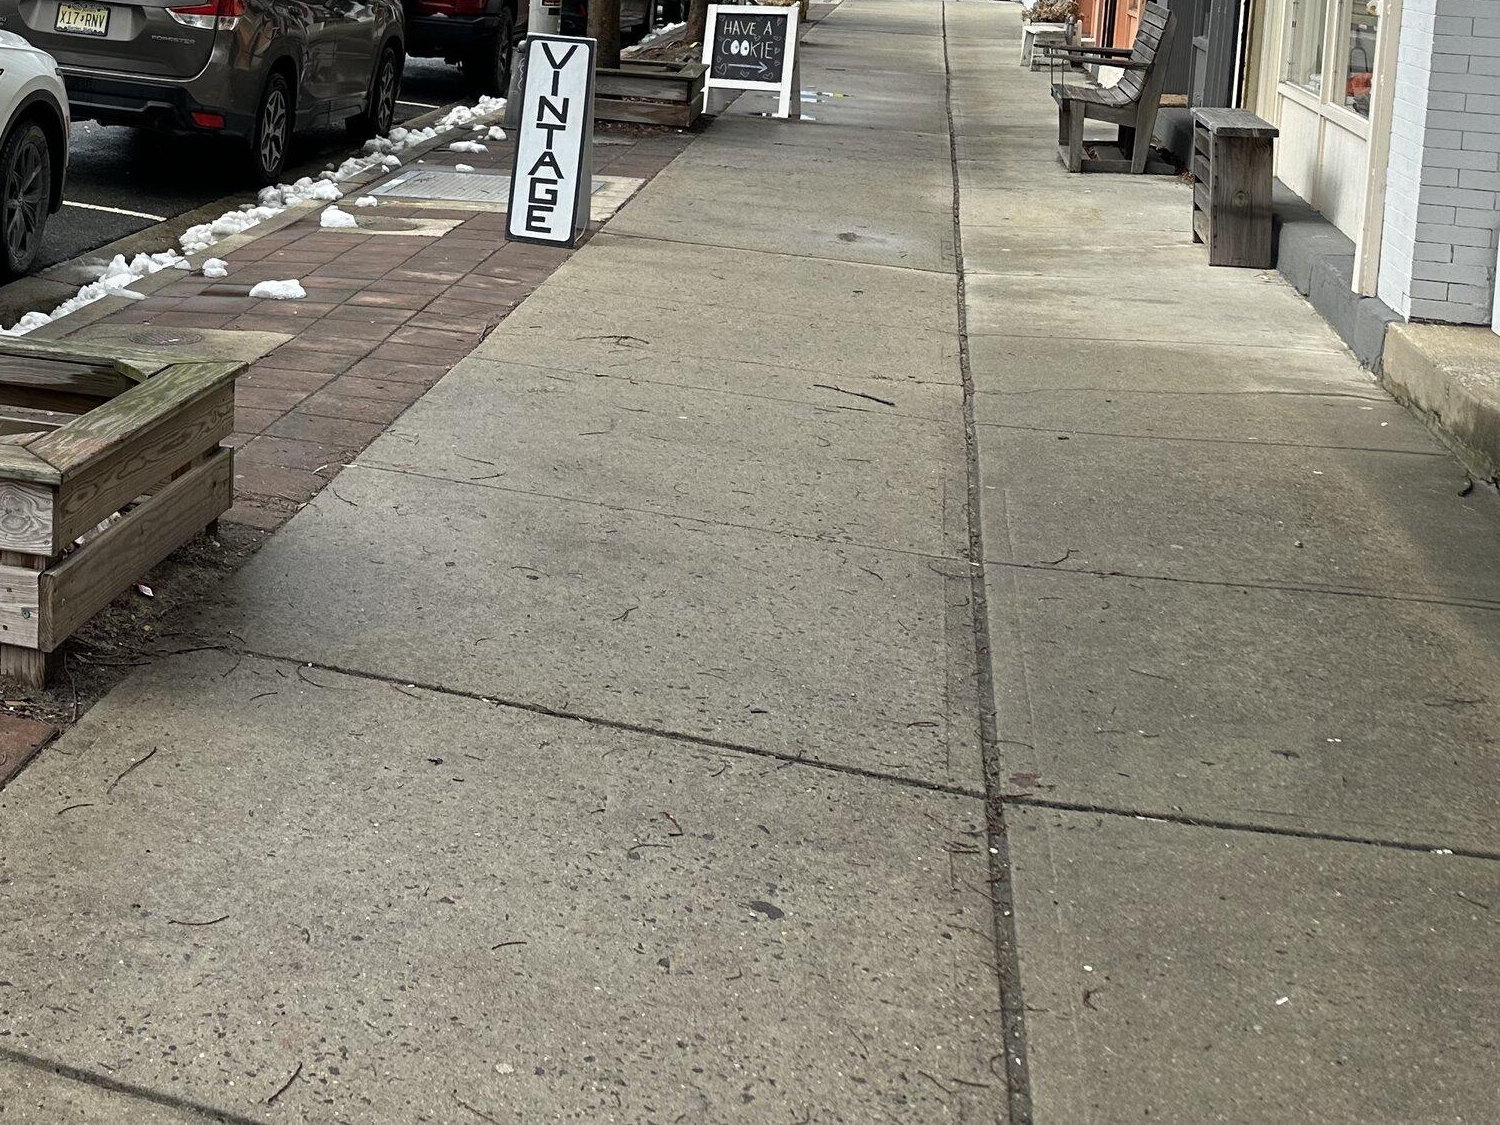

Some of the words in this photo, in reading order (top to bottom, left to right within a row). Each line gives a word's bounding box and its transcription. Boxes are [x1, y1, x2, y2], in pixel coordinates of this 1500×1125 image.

[723, 20, 757, 36] HAVE
[762, 21, 773, 36] A
[721, 38, 774, 60] COOKIE
[525, 42, 579, 234] VINTAGE
